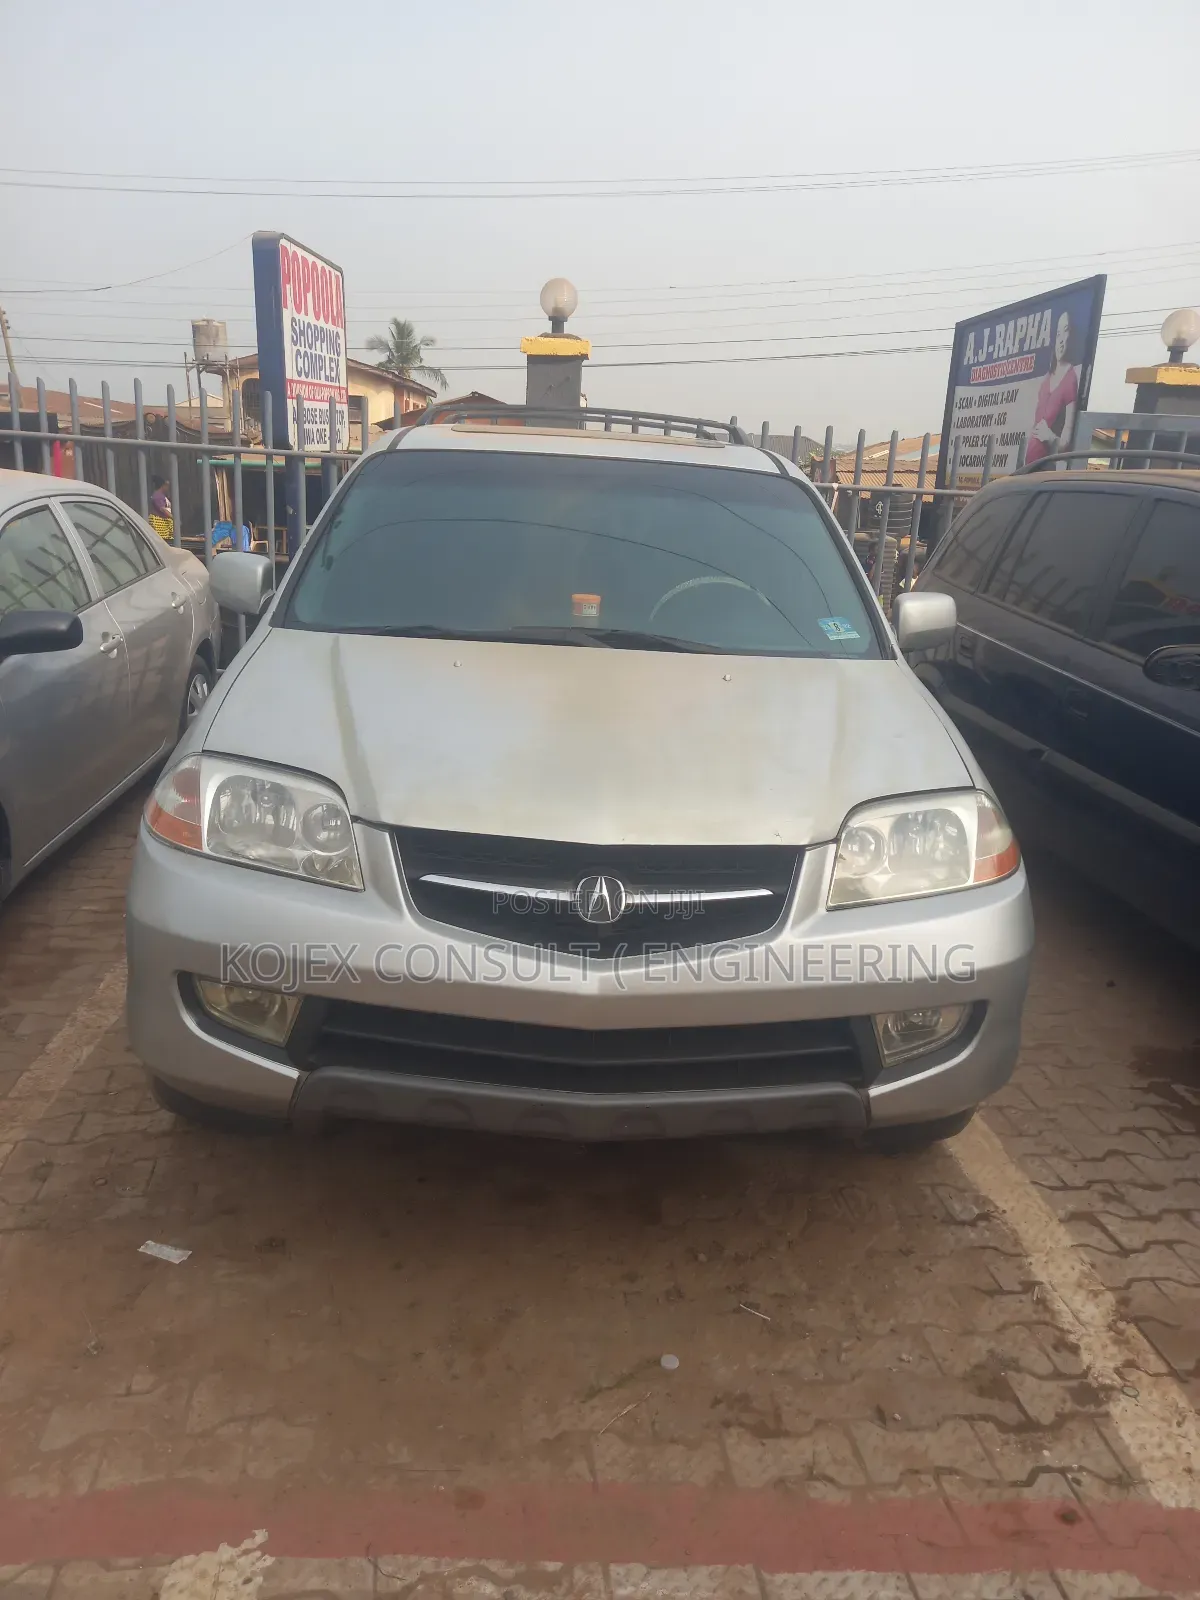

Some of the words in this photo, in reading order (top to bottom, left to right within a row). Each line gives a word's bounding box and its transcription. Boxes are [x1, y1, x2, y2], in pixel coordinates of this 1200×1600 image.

[280, 243, 344, 329] POPOOLA
[291, 316, 341, 357] SHOPPING
[964, 309, 1052, 365] A.J-RAPHA
[295, 349, 340, 384] COMPLEX
[958, 395, 974, 410] SCAN
[977, 392, 1000, 408] DIGITAL
[1000, 388, 1019, 405] X-RAY
[318, 408, 330, 426] BUS
[956, 413, 994, 429] LABORATORY
[996, 411, 1008, 426] ECG
